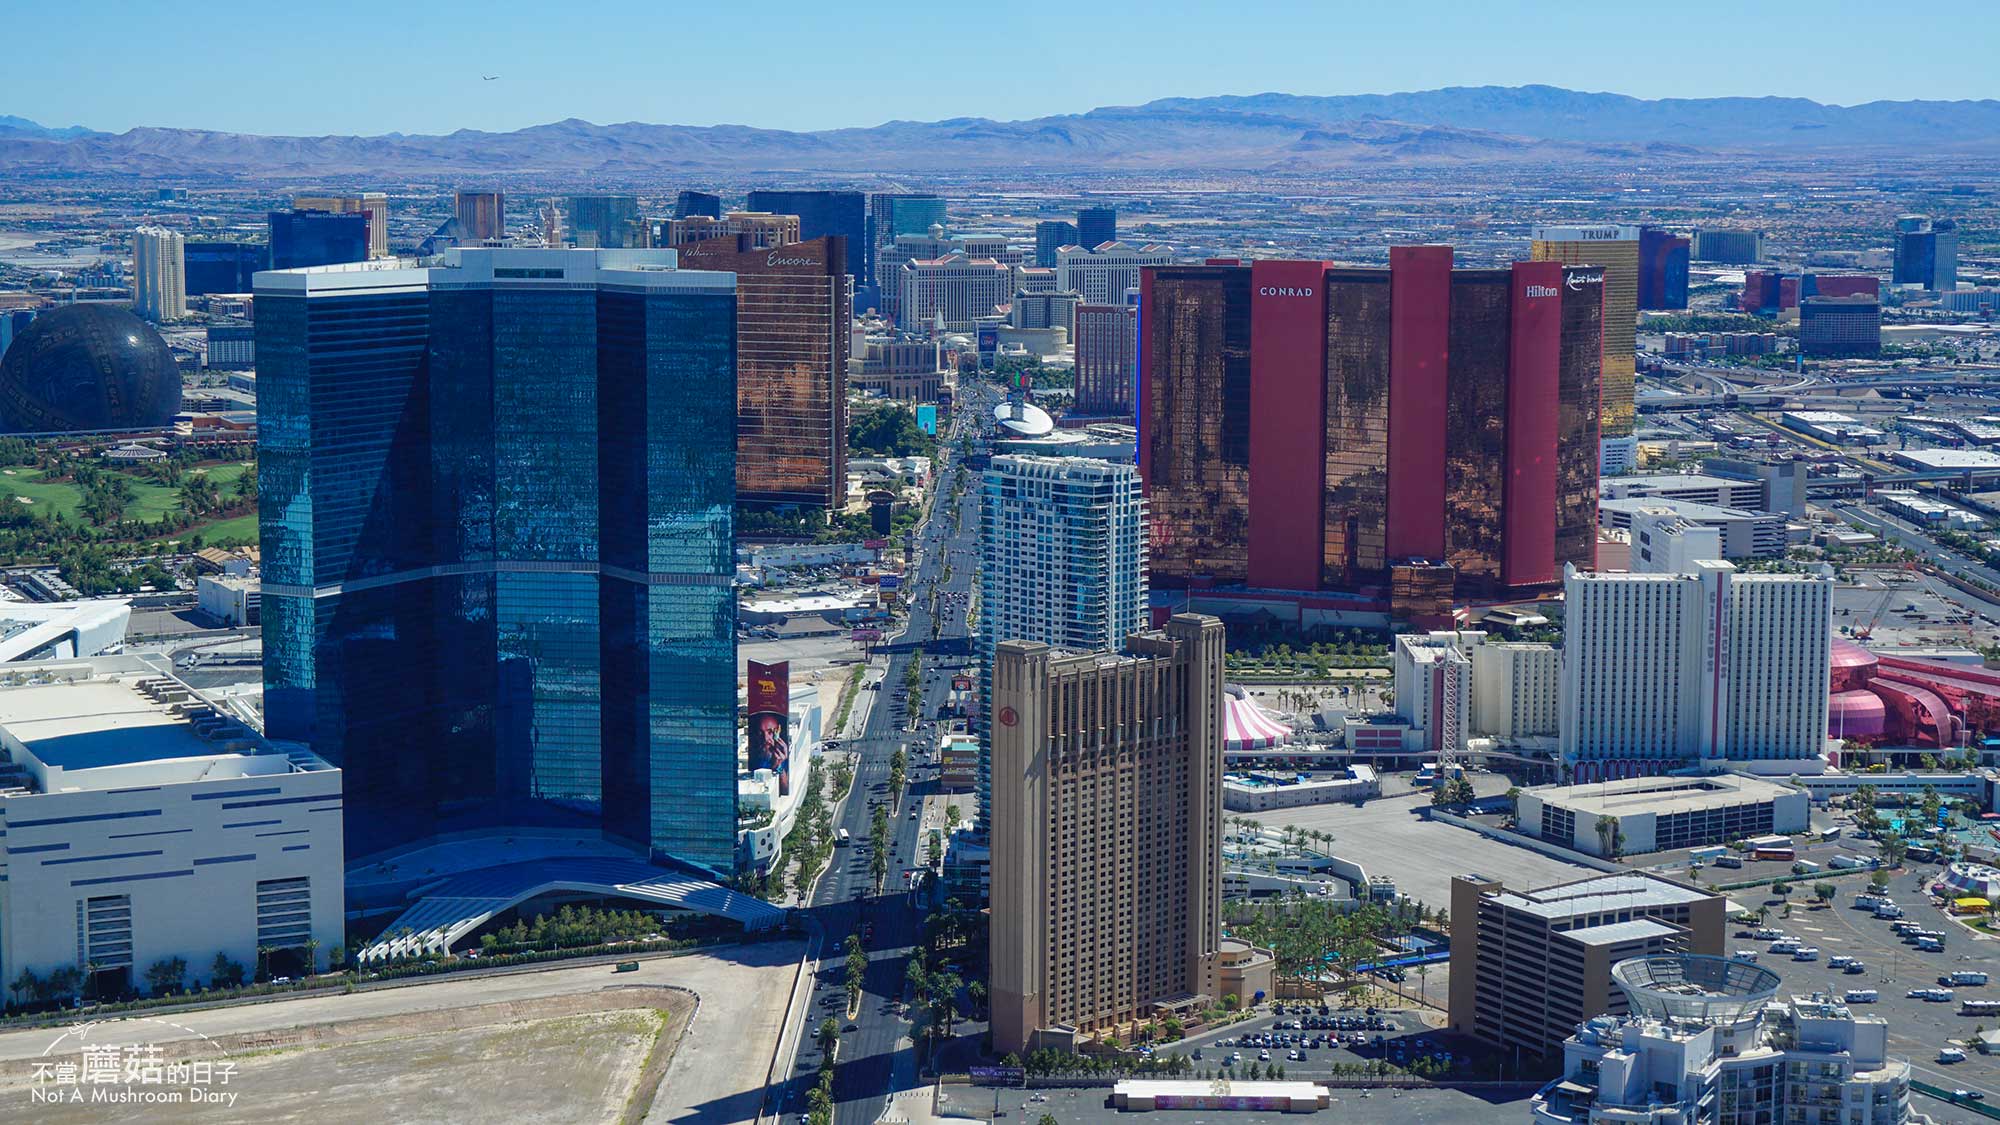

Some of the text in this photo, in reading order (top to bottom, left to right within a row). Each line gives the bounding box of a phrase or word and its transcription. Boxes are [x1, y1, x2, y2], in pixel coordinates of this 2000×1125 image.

[1581, 230, 1619, 239] TRUMP
[767, 250, 821, 266] Encore
[1260, 287, 1312, 296] CONRAD
[1526, 285, 1557, 297] Hilton
